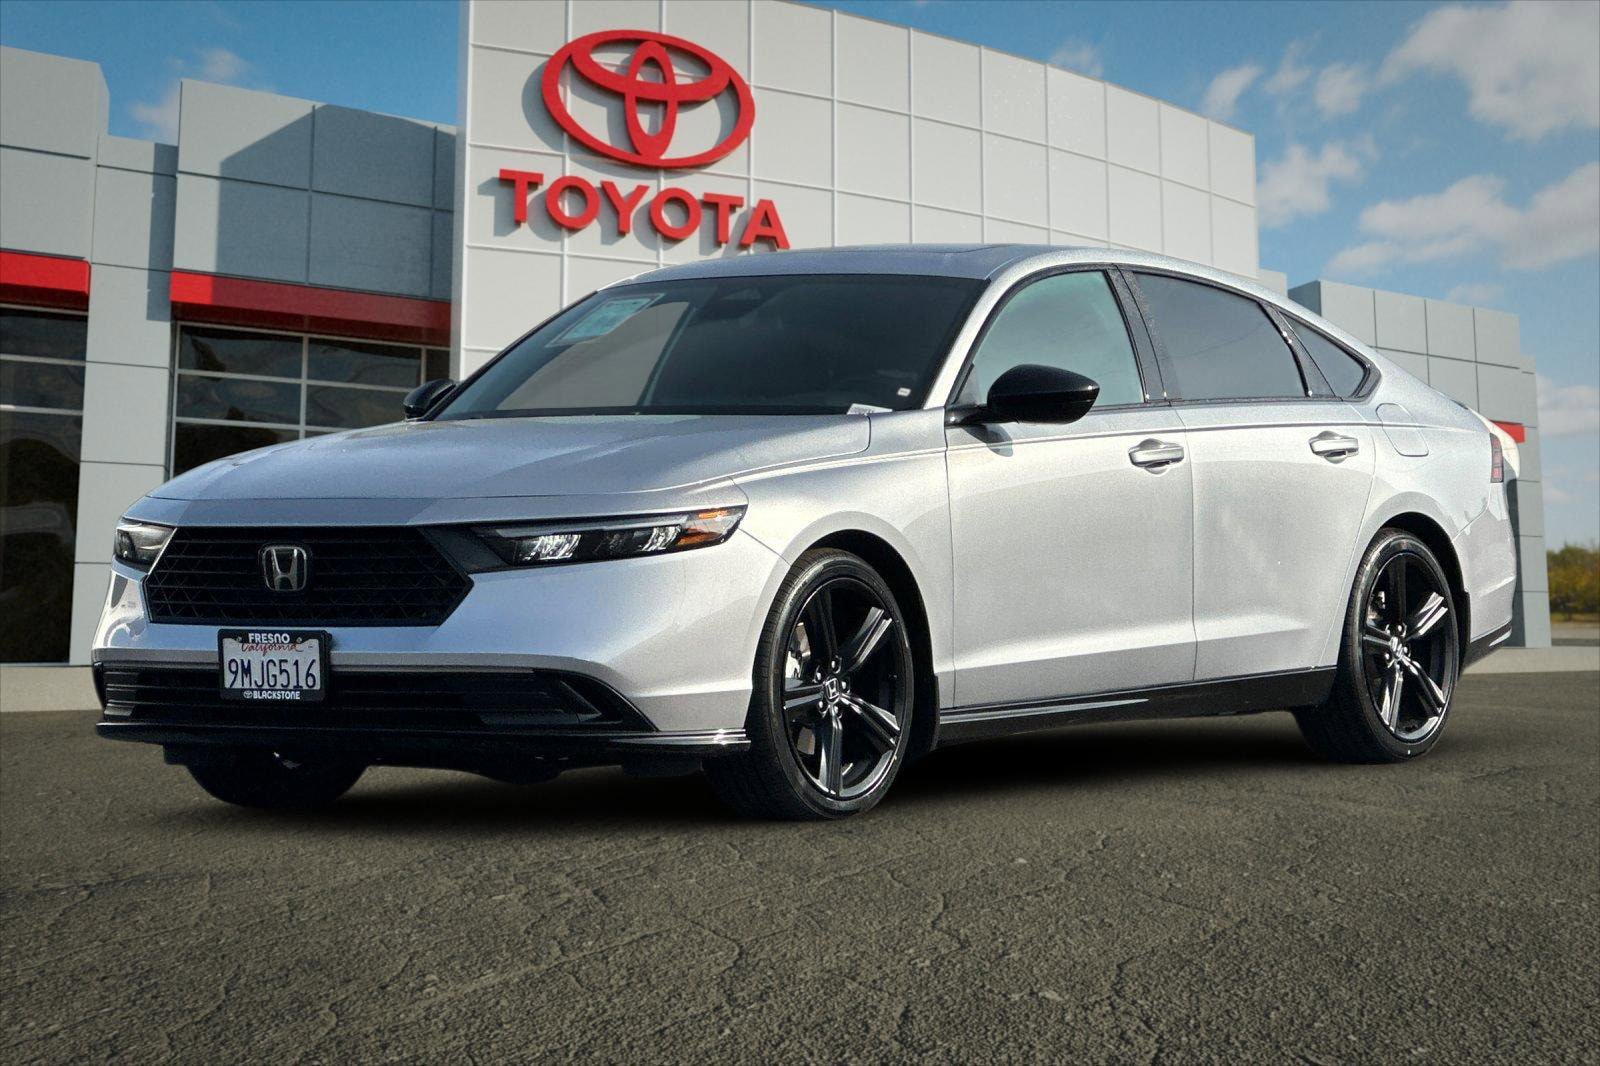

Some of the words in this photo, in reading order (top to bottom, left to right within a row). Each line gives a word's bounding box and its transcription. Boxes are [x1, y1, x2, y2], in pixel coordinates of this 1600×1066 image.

[499, 168, 790, 249] TOYOTA
[248, 633, 291, 643] FRESNO
[227, 658, 317, 688] 9MJG516
[253, 690, 301, 700] BLACKSTONE
